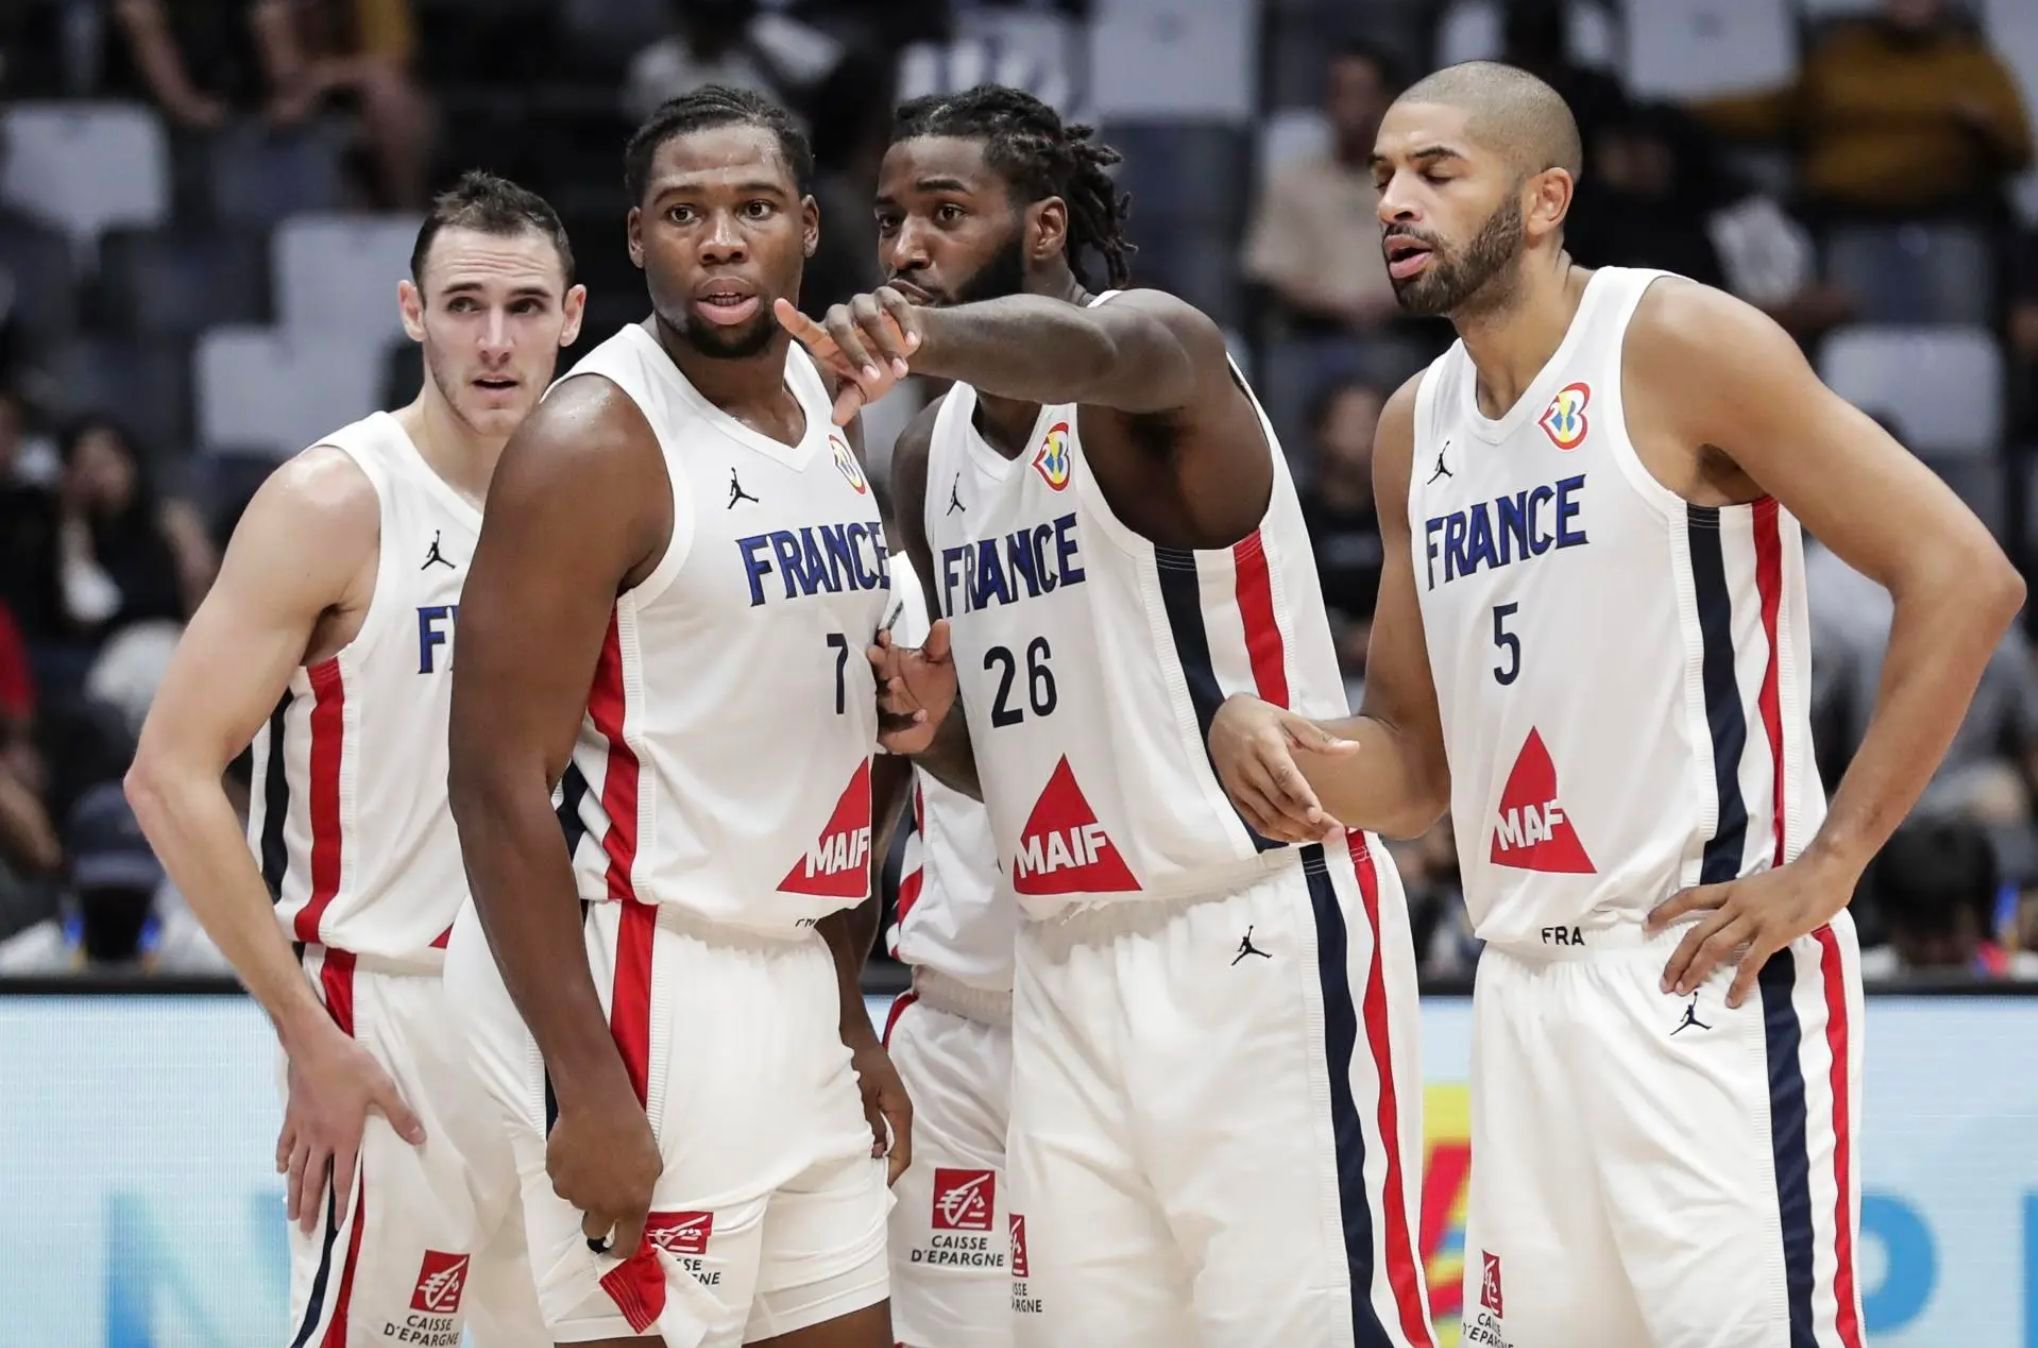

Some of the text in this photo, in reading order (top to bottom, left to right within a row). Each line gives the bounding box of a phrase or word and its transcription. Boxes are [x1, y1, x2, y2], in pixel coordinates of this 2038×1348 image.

[735, 521, 891, 607] FRANCE
[942, 512, 1086, 617] FRANCE
[1426, 473, 1591, 592] FRANCE
[826, 633, 849, 715] 7
[983, 636, 1058, 728] 26
[1493, 601, 1521, 685] 5
[805, 826, 871, 879] MAIF
[1015, 822, 1107, 879] MAIF
[1541, 926, 1586, 946] FRA
[931, 1234, 988, 1251] CAISSE
[406, 1314, 454, 1332] CAISSE
